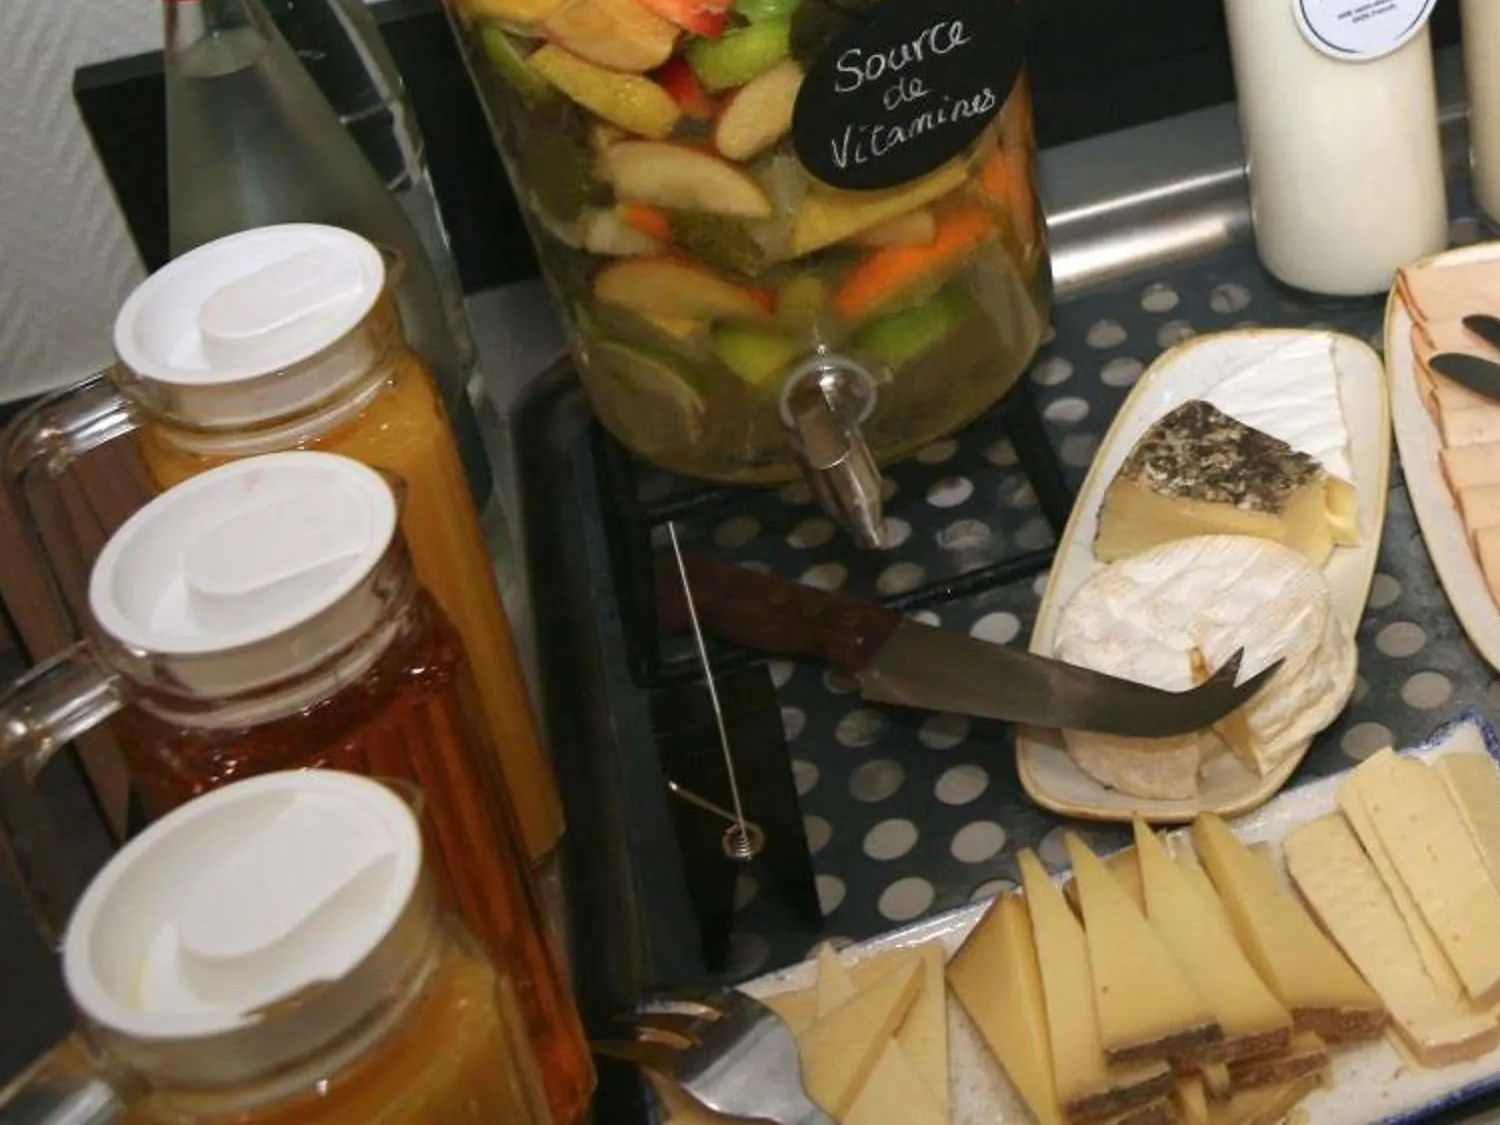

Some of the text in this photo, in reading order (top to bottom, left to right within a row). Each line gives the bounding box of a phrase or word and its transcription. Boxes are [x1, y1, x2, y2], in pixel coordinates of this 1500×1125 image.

[834, 20, 972, 92] Source
[831, 87, 996, 169] Vitamines
[883, 77, 932, 110] de
